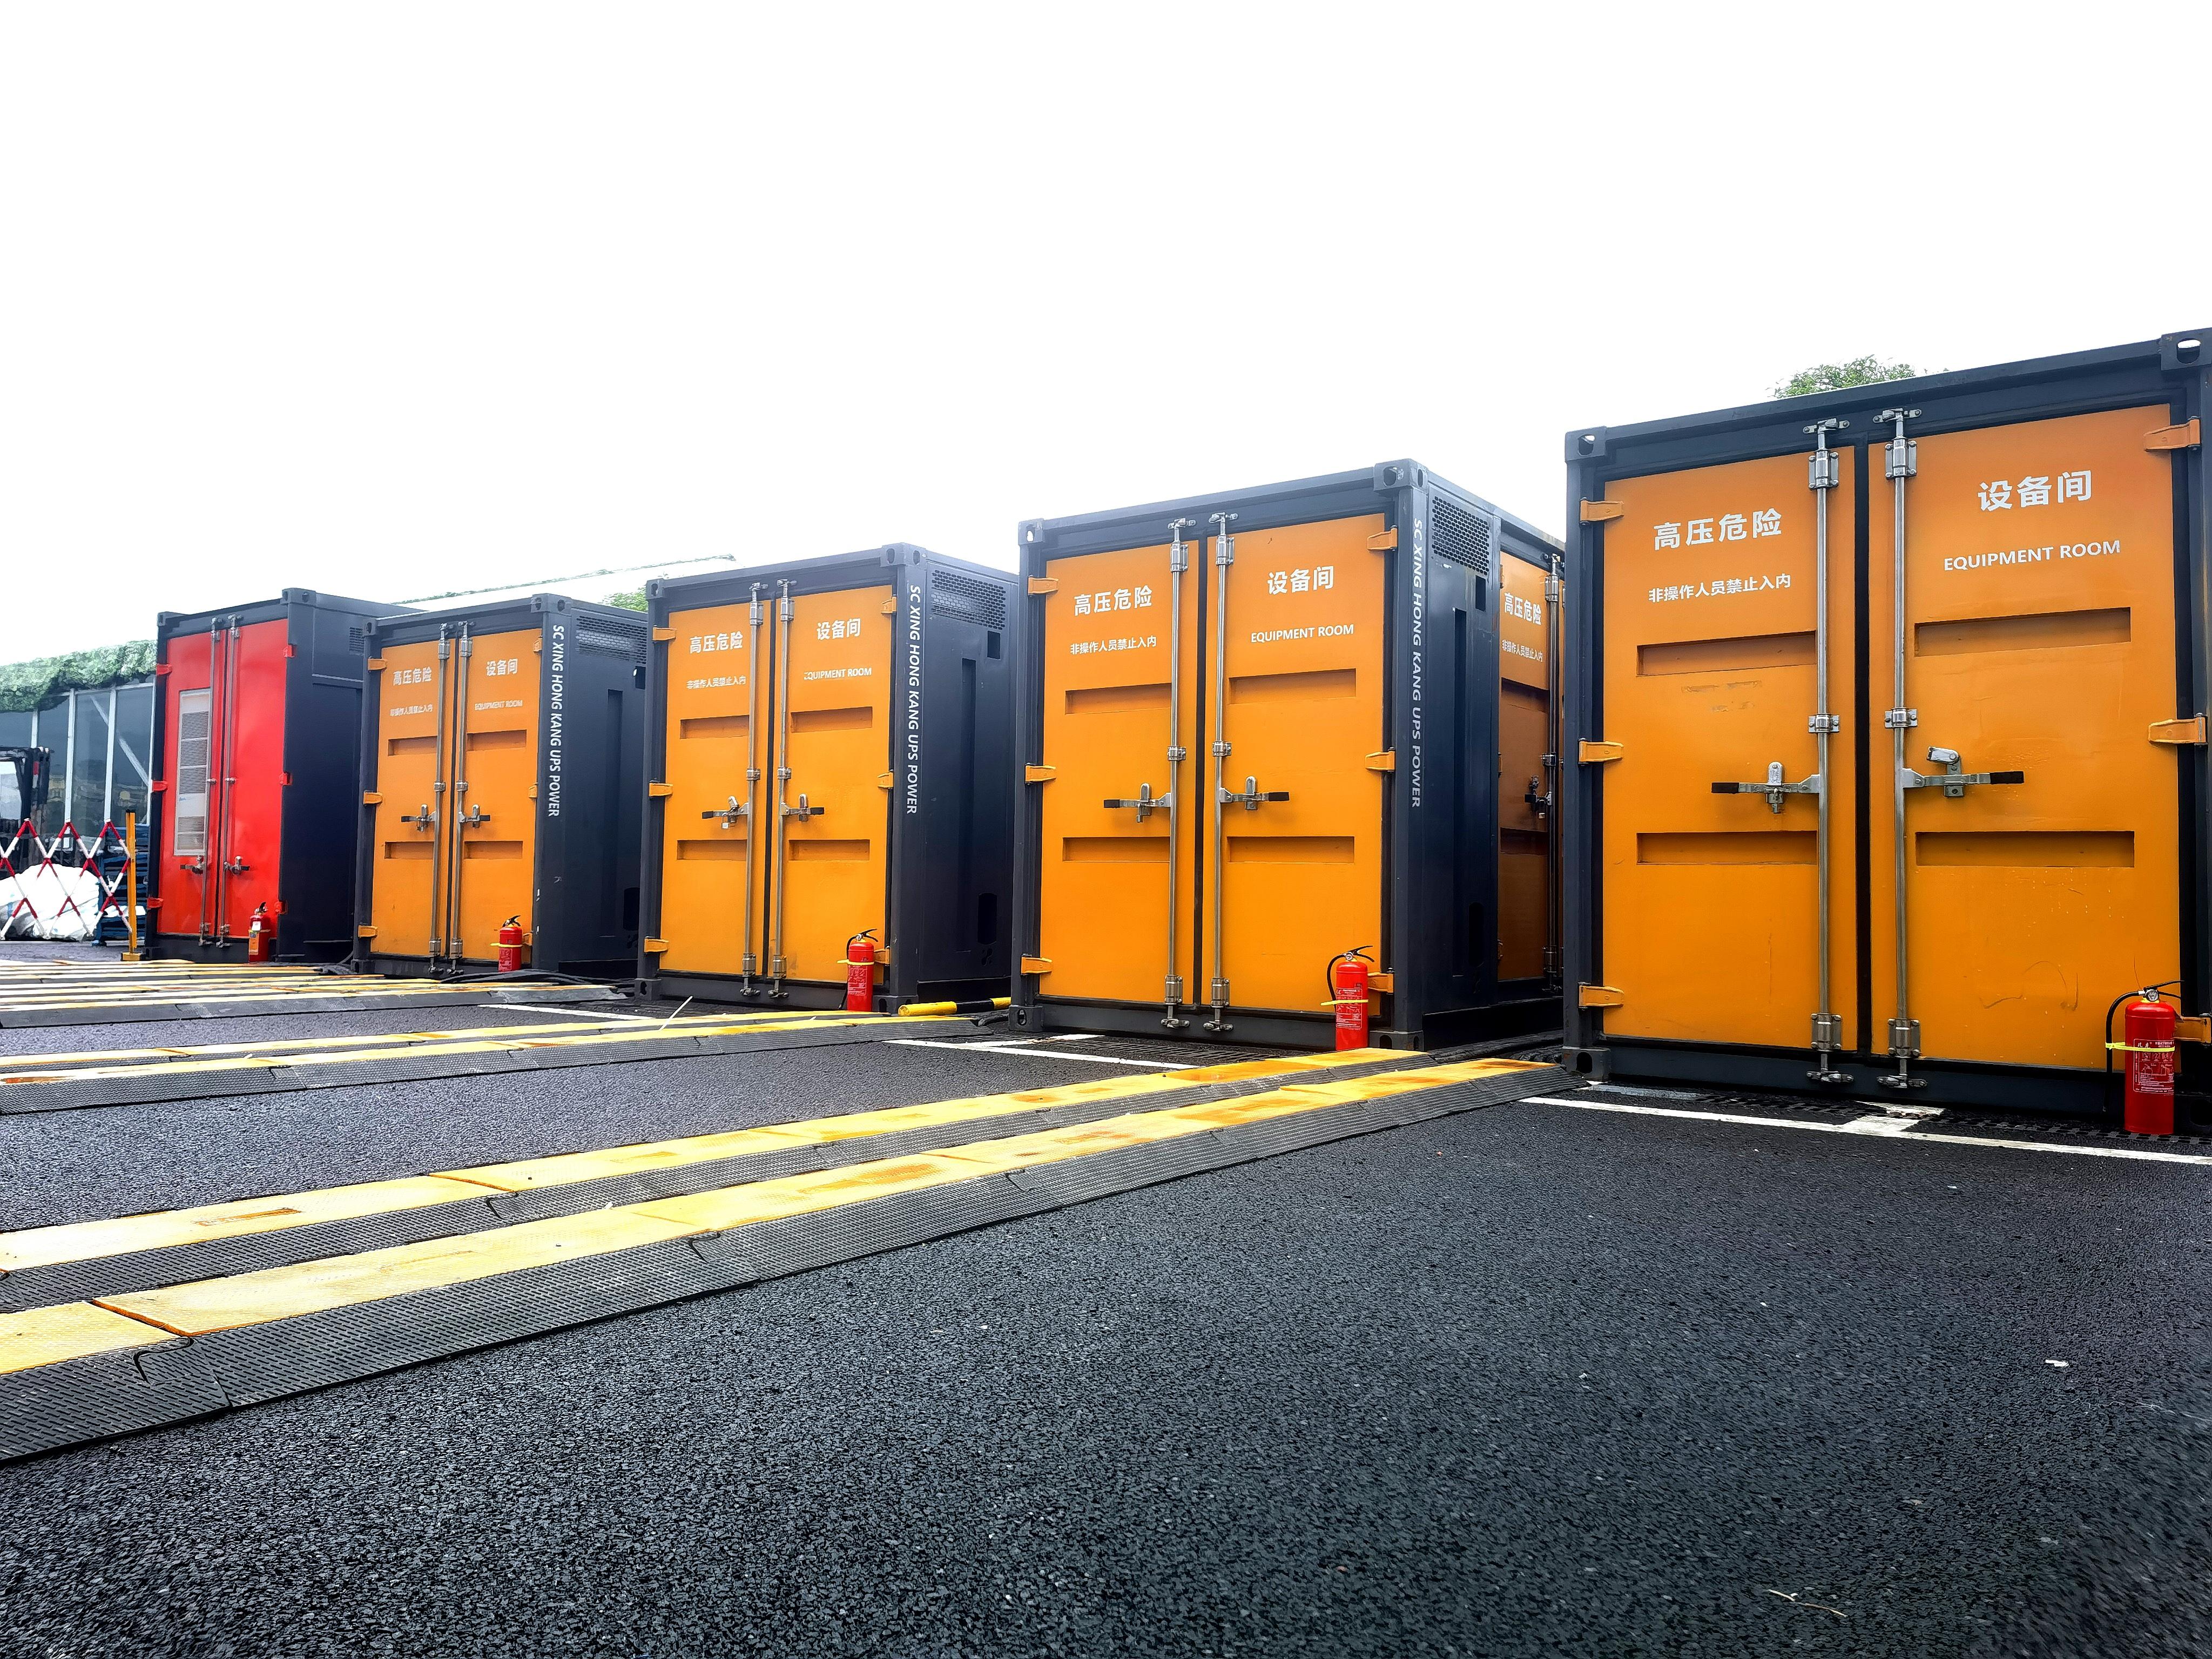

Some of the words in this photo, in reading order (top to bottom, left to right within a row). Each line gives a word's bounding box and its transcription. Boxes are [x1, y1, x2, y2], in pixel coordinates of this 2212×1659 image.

[1978, 470, 2092, 512] 设备间
[1414, 518, 1422, 541] SC
[1653, 508, 1782, 551] 高压危险
[1413, 543, 1422, 588] XING
[1944, 546, 2053, 571] EQUIPMENT
[2059, 540, 2120, 559] ROOM
[910, 585, 921, 603] SC
[1267, 565, 1334, 595] 设备间
[1648, 573, 1791, 603] 非操作人员禁止入内
[1074, 585, 1152, 616] 高压危险
[1504, 592, 1542, 625] 高压危险
[552, 624, 564, 640] SC
[816, 617, 861, 640] 设备间
[909, 605, 920, 640] XING
[1251, 627, 1315, 643] EQUIPMENT
[1318, 624, 1354, 637] ROOM
[1413, 592, 1422, 646] HONG
[552, 642, 564, 671] XING
[689, 631, 744, 654] 高压危险
[1070, 635, 1157, 655] 非操作人员禁止入内
[393, 666, 432, 686] 高压危险
[485, 658, 518, 677] 设备间
[804, 669, 846, 680] EQUIPMENT
[847, 667, 872, 678] ROOM
[909, 644, 920, 686] HONG
[1412, 651, 1421, 701] KANG
[551, 675, 563, 710] HONG
[908, 690, 919, 730] KANG
[1412, 707, 1421, 740] UPS
[550, 713, 562, 746] KANG
[549, 750, 561, 772] UPS
[908, 734, 919, 760] UPS
[907, 764, 918, 814] POWER
[1412, 745, 1420, 807] POWER
[548, 775, 561, 817] POWER
